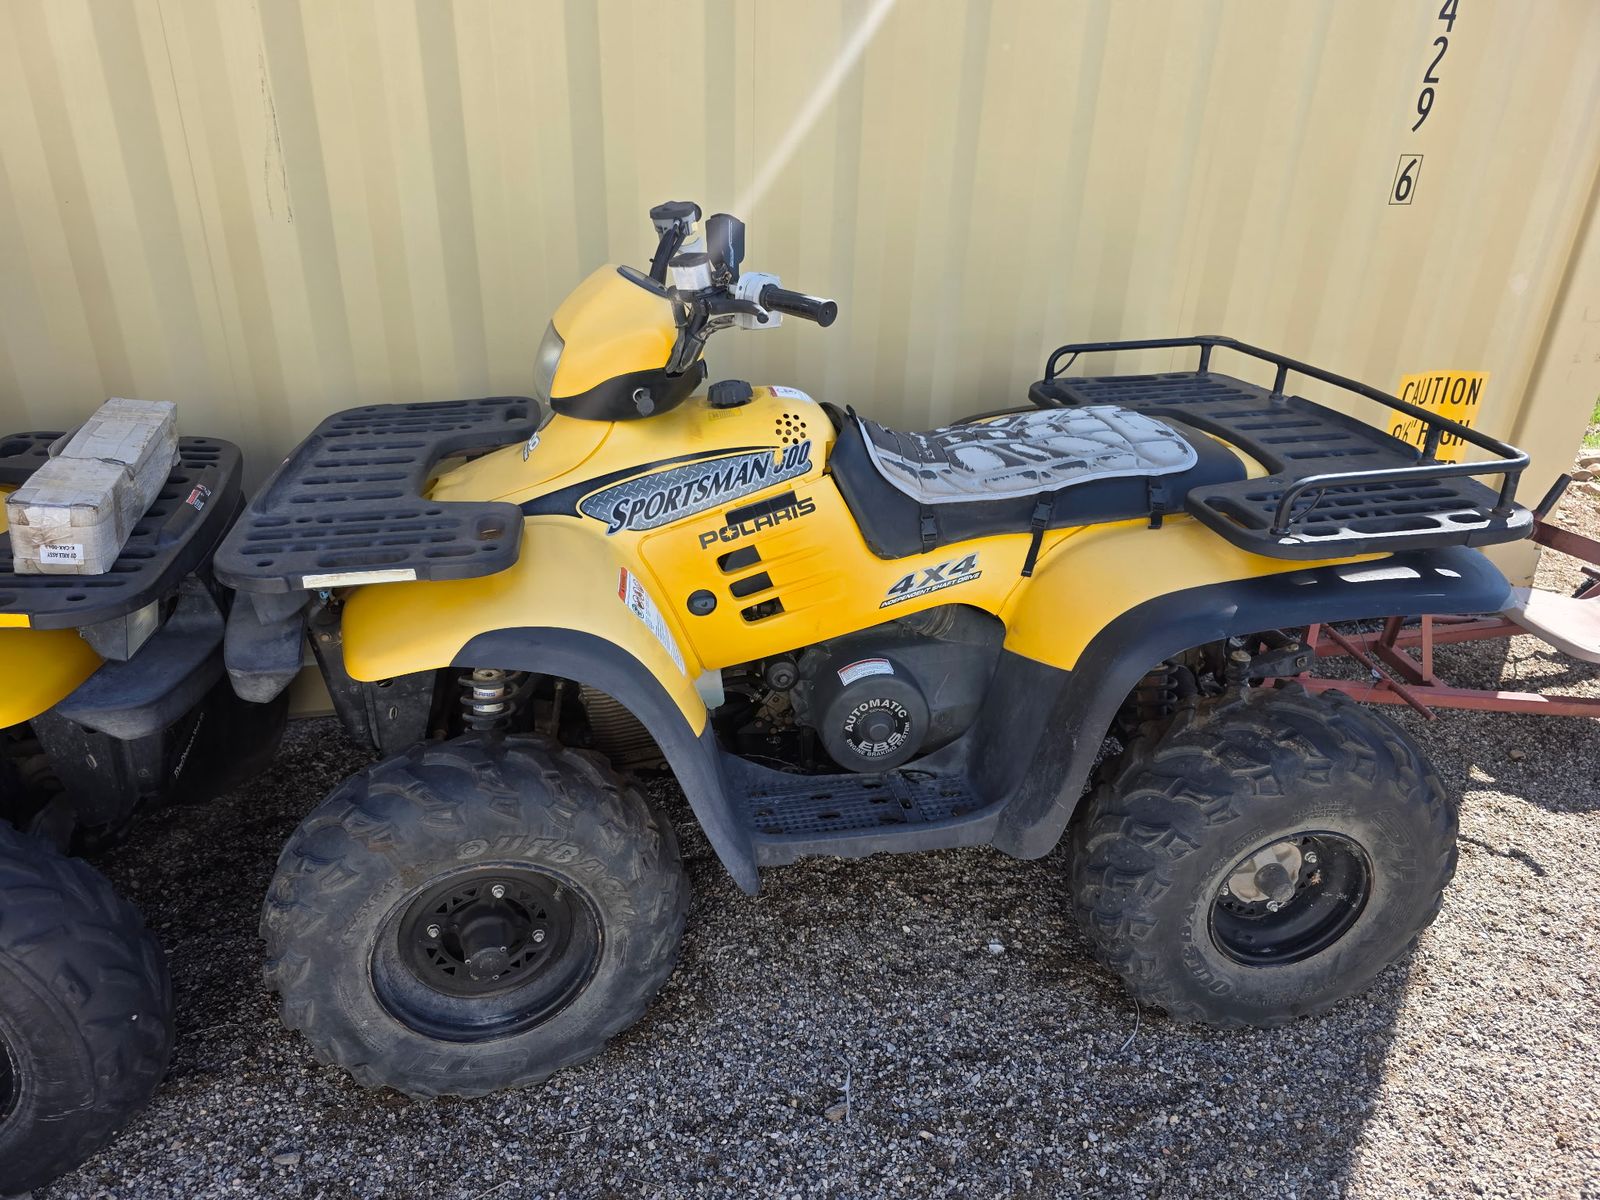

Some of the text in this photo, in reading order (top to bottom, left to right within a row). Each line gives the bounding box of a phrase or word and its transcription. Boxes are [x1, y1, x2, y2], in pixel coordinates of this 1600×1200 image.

[1395, 158, 1418, 202] 6
[1402, 376, 1483, 405] CAUTION
[608, 452, 770, 535] SPORTSMAN
[698, 497, 816, 550] POLARIS
[931, 580, 957, 591] SHAFT
[956, 572, 980, 584] DRIVE
[845, 699, 907, 732] AUTOMATIC
[846, 721, 910, 757] ENGINE BRAKING SYSTEM
[858, 732, 901, 752] EBS
